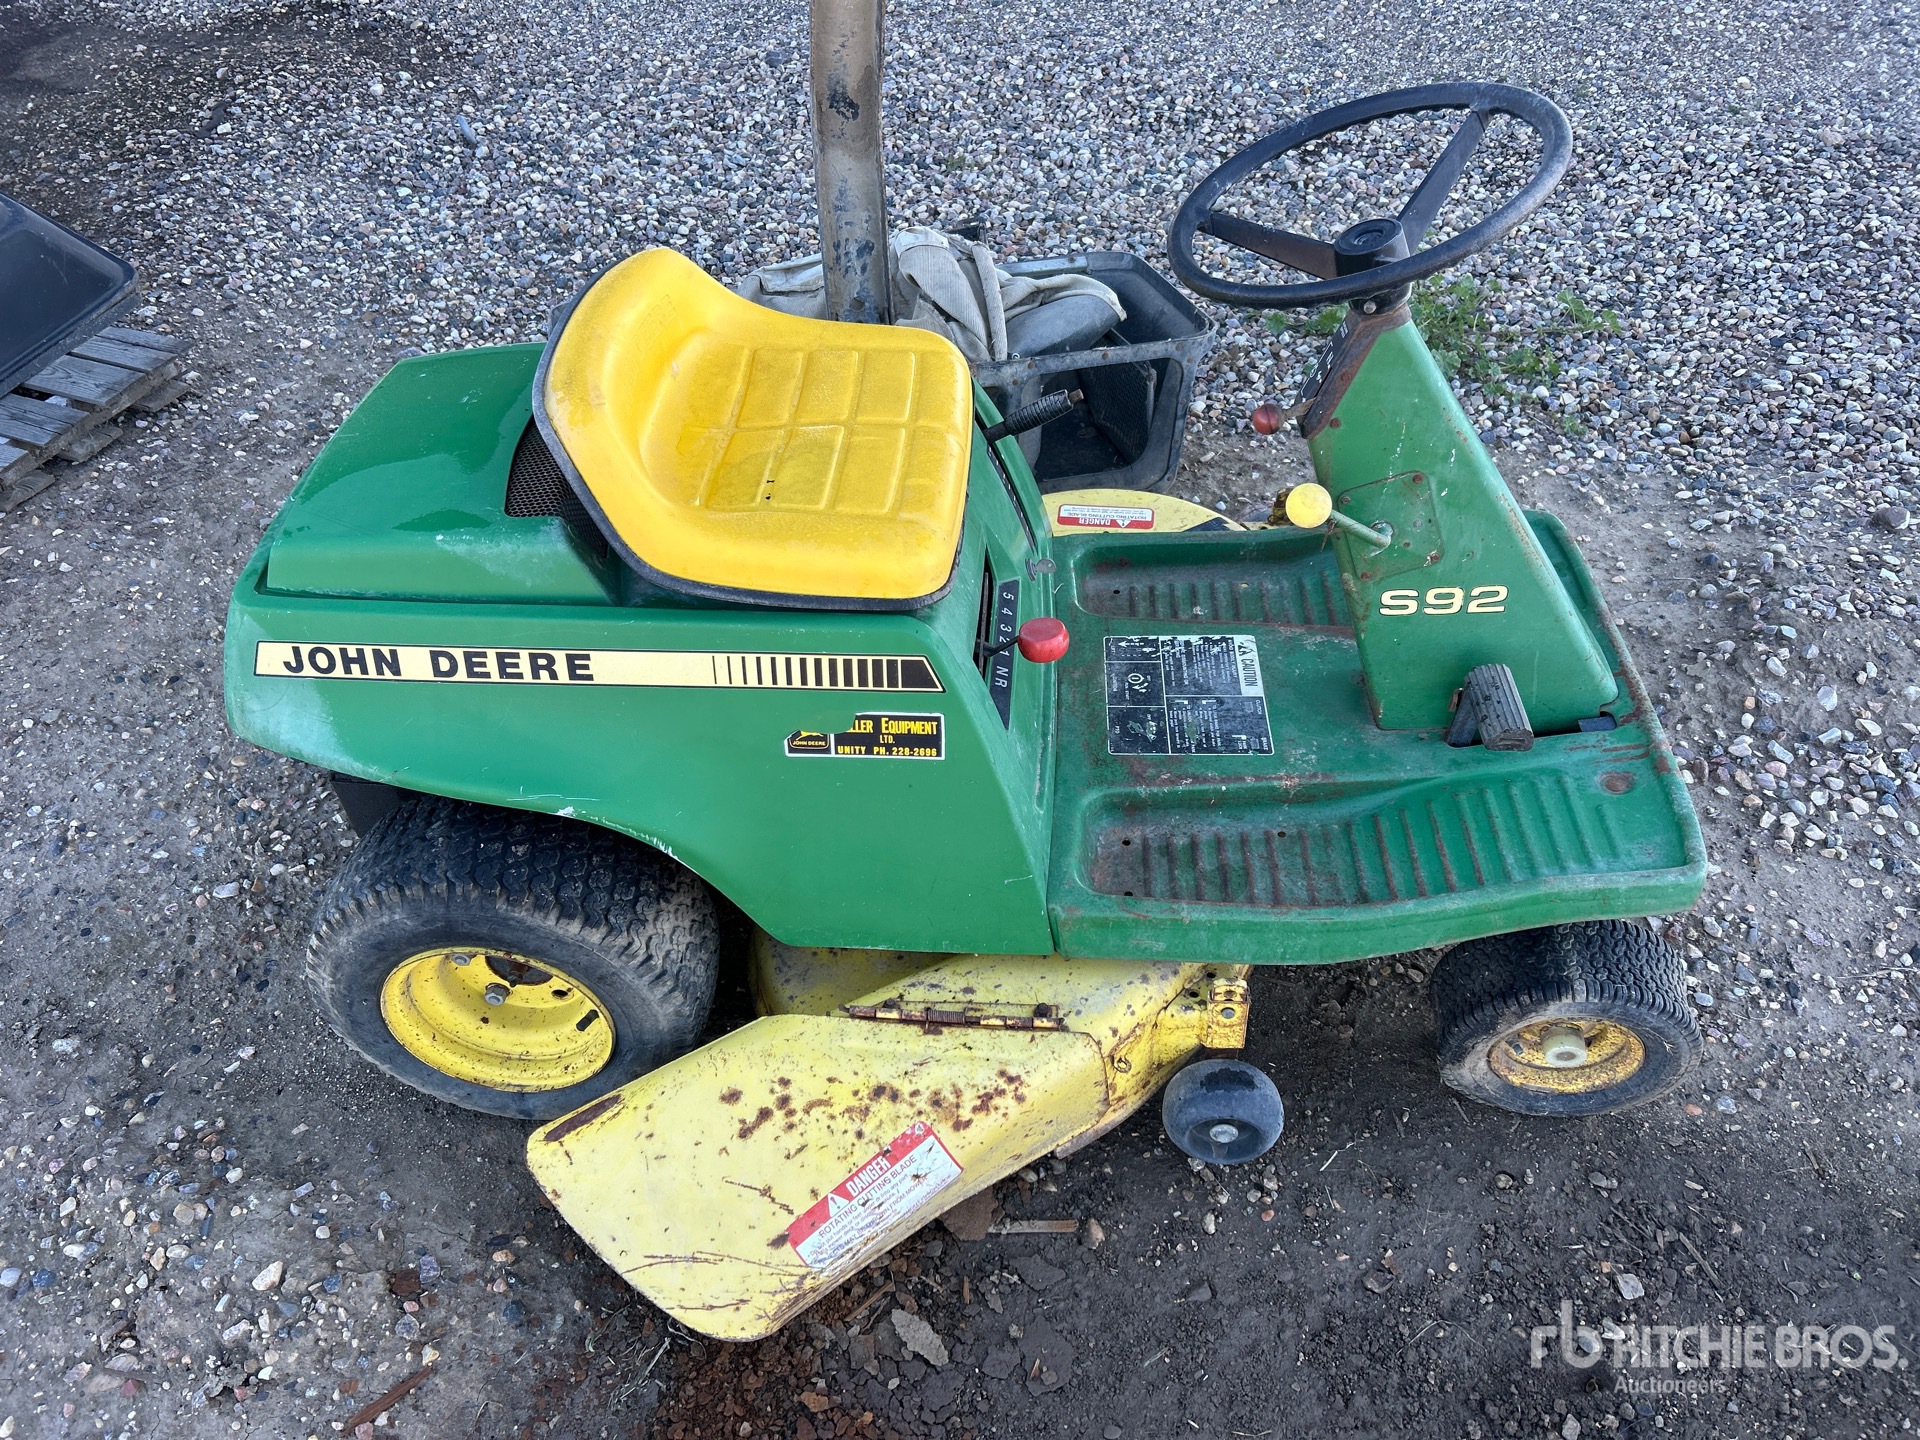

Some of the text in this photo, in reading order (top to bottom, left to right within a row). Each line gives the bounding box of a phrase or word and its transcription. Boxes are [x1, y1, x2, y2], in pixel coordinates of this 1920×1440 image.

[1079, 517, 1111, 526] DANGER
[1003, 591, 1015, 601] 5
[1378, 585, 1509, 616] S92
[1001, 606, 1013, 616] 4
[1000, 623, 1012, 633] 3
[283, 646, 595, 681] JOHN DEERE
[1240, 657, 1259, 686] CAUTION
[879, 735, 896, 744] LTD.
[837, 745, 937, 757] UNITY PH. 228-2696
[845, 1155, 892, 1198] DANGER
[818, 1204, 858, 1239] ROTATING
[857, 1177, 893, 1208] CUTTING
[890, 1154, 917, 1179] BLADE
